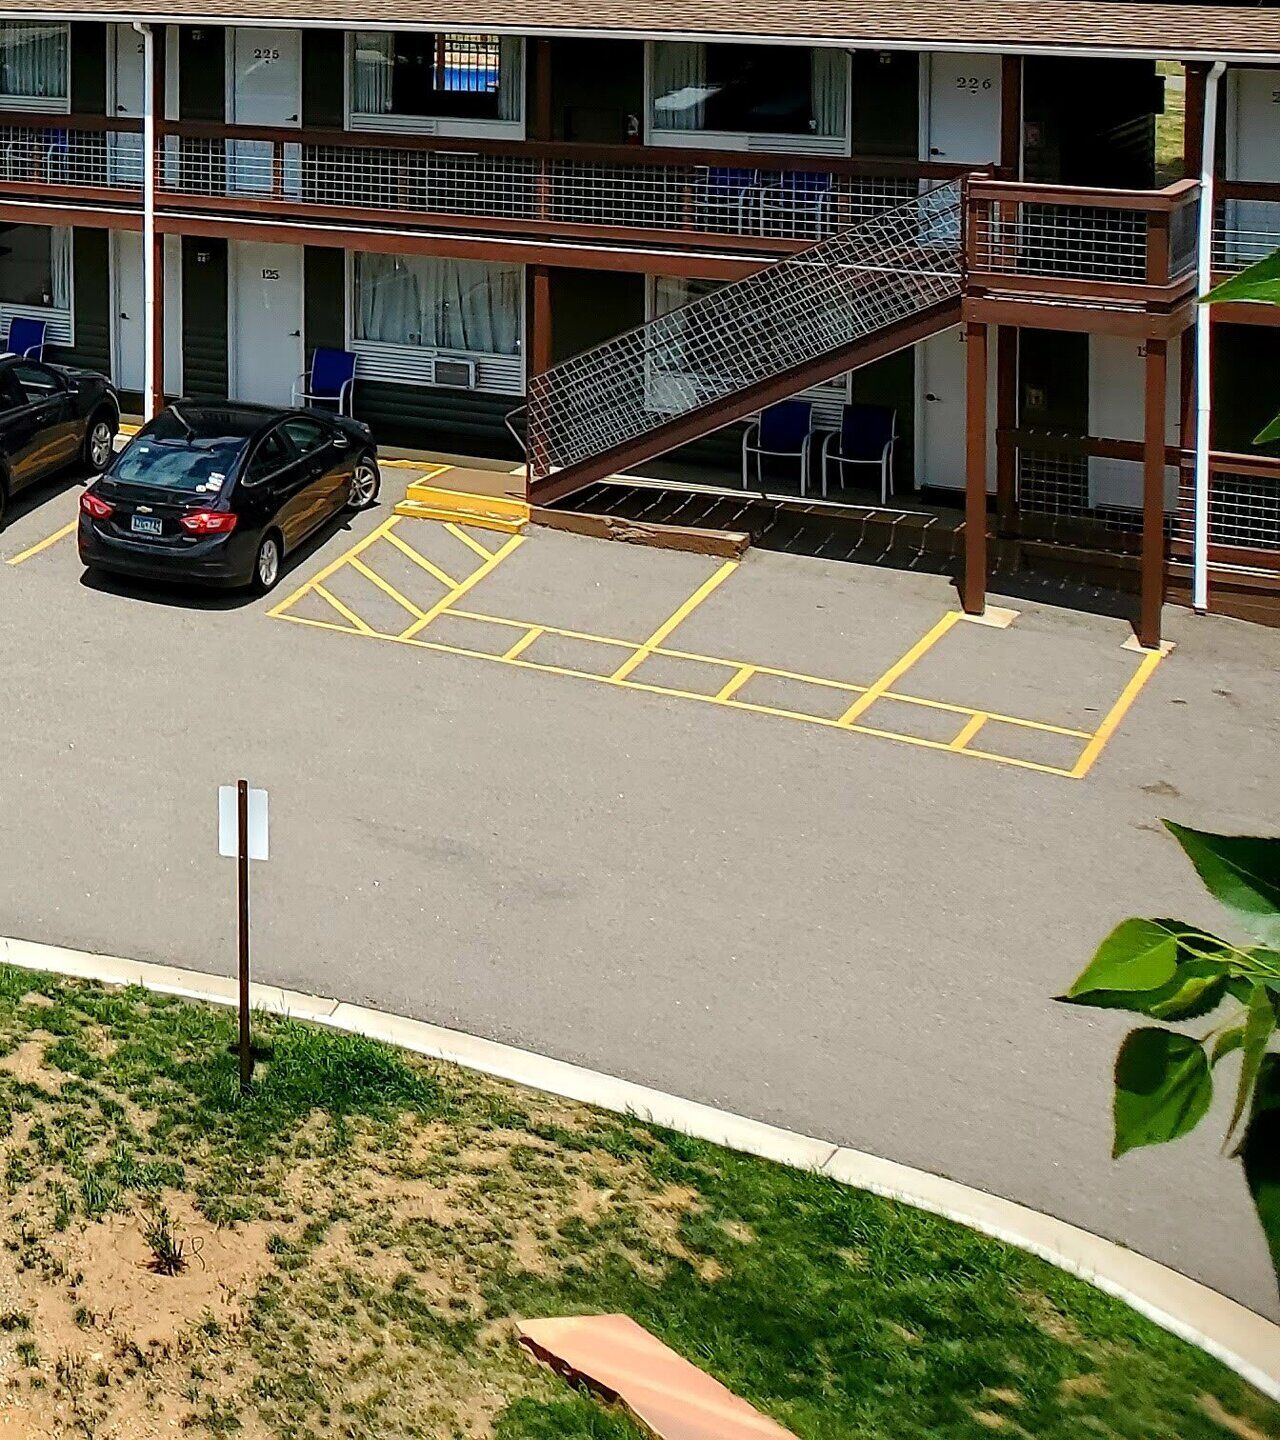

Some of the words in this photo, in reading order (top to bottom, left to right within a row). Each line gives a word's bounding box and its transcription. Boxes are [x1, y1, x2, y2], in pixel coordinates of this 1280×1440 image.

[253, 48, 280, 60] 225
[956, 76, 992, 90] 226
[262, 268, 280, 280] 125
